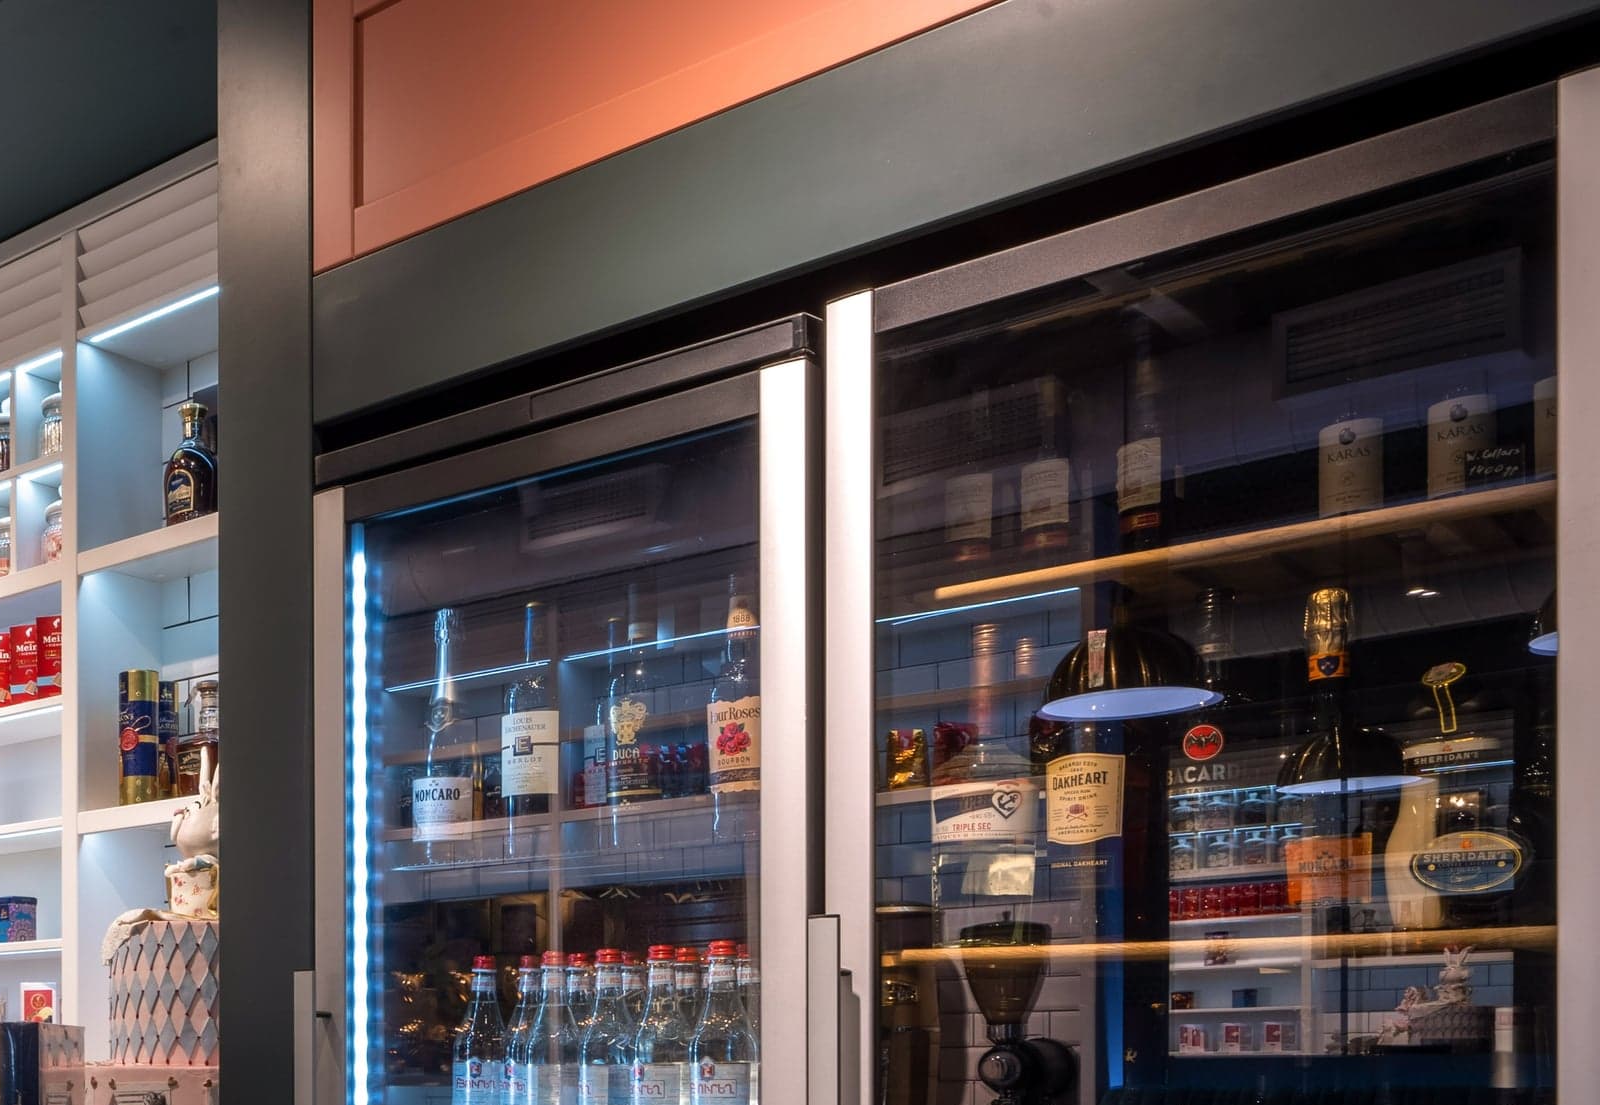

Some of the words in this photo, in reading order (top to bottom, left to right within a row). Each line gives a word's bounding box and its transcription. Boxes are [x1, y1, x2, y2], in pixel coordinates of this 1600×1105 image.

[1436, 423, 1488, 442] KARAS
[1328, 447, 1370, 464] KARAS
[729, 702, 760, 721] Roses
[613, 747, 641, 761] DUCA
[717, 756, 751, 767] BOURBON
[1052, 770, 1109, 791] OAKHEART
[1167, 764, 1240, 787] BACARD
[414, 787, 461, 803] MONCARO
[953, 823, 976, 832] TRIPLE
[977, 822, 992, 831] SEC
[1423, 850, 1509, 864] SHERIDAN'S
